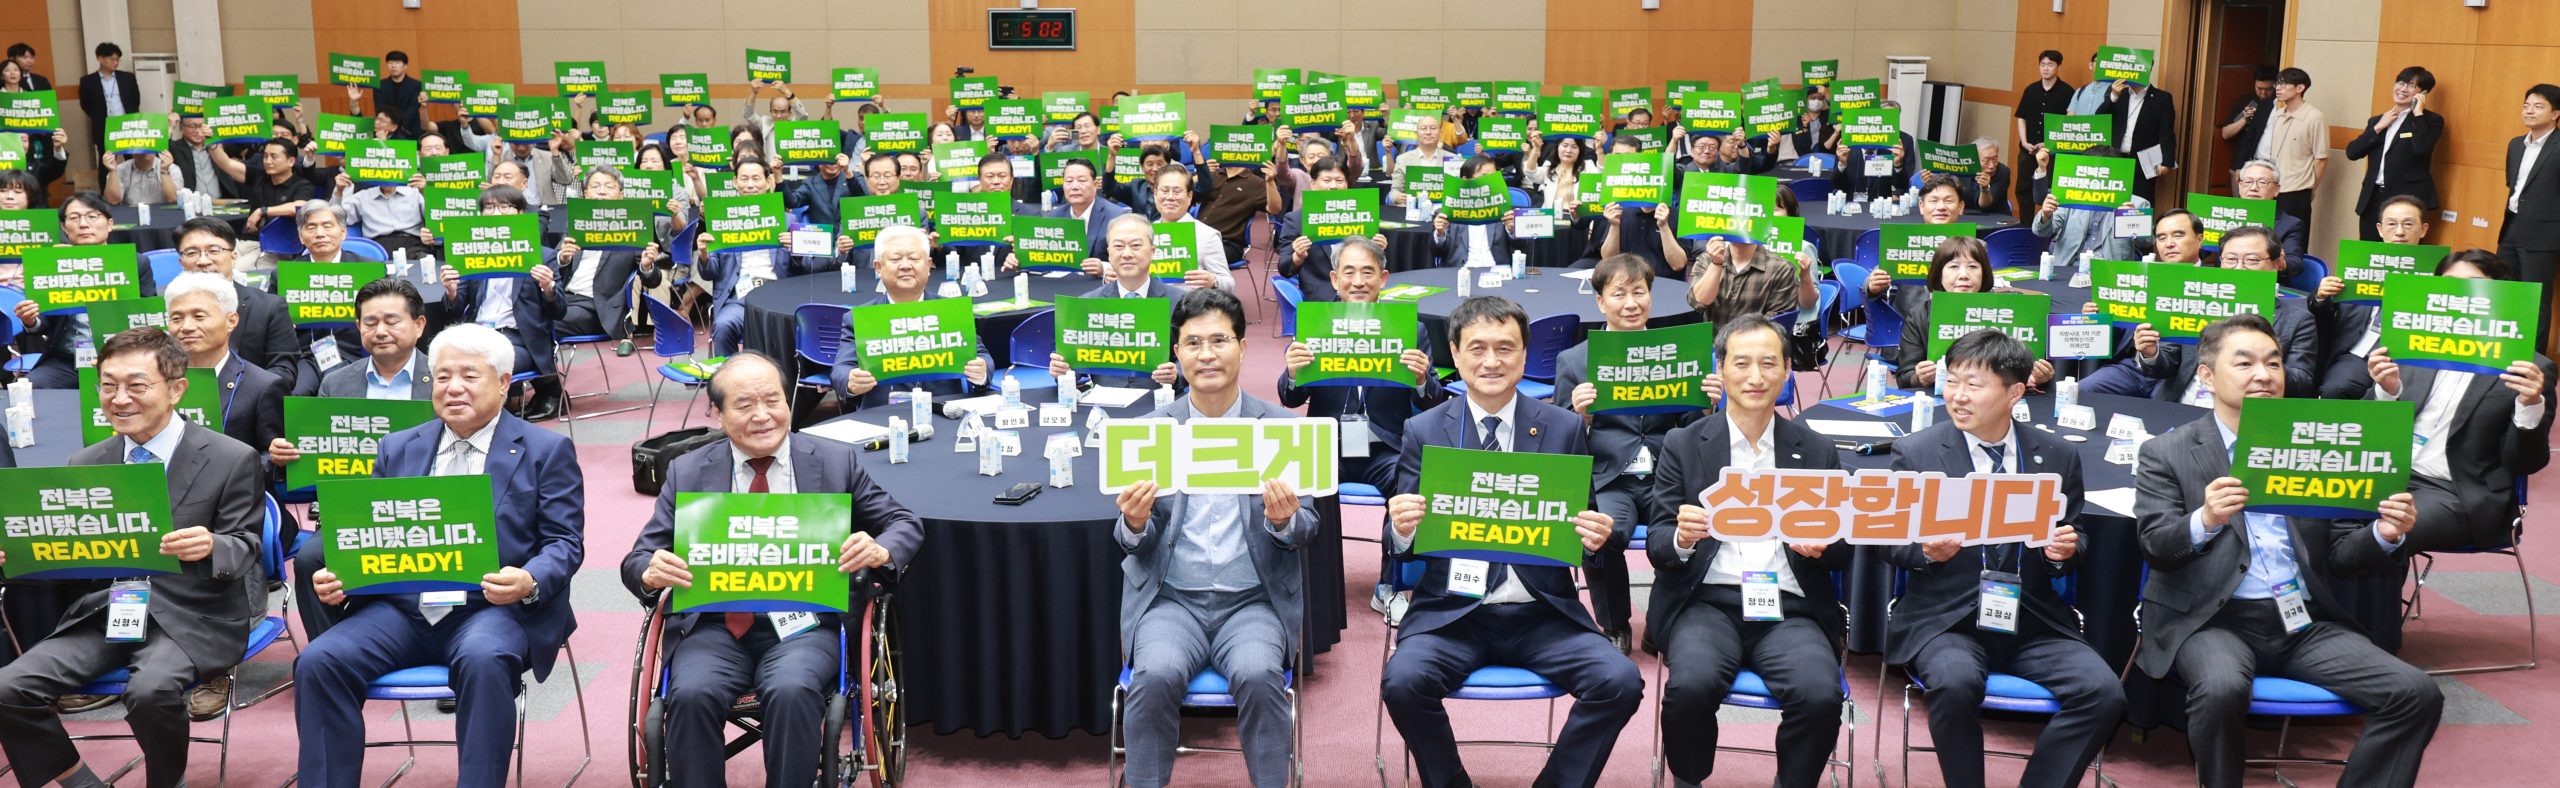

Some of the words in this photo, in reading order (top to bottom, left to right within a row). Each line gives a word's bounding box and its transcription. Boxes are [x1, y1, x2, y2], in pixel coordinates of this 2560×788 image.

[1299, 93, 1328, 104] 전북은
[220, 104, 247, 115] 전북은
[1137, 103, 1166, 113] 전북은
[122, 121, 149, 129] 전북은
[883, 121, 909, 130] 전북은
[1294, 114, 1334, 123] READY!
[217, 125, 257, 135] READY!
[794, 129, 820, 138] 전북은
[1131, 122, 1173, 133] READY!
[115, 139, 155, 148] READY!
[1228, 133, 1254, 142] 전북은
[878, 141, 915, 149] READY!
[366, 148, 390, 157] 전북은
[789, 150, 828, 158] READY!
[360, 169, 403, 178] READY!
[1621, 163, 1650, 174] 전북은
[2076, 166, 2109, 178] 전북은
[2058, 176, 2126, 191] 준비됐습니다.
[1460, 185, 1490, 197] 전북은
[1613, 188, 1657, 198] READY!
[1707, 185, 1747, 199] 전북은
[2066, 190, 2115, 202] READY!
[727, 205, 760, 218] 전북은
[864, 205, 897, 217] 전북은
[956, 202, 988, 213] 전북은
[1325, 200, 1356, 210] 전북은
[1686, 200, 1766, 218] 준비됐습니다.
[592, 209, 627, 219] 전북은
[941, 214, 1006, 225] 준비됐습니다.
[1308, 210, 1373, 224] 준비됐습니다.
[1453, 208, 1498, 218] READY!
[2211, 206, 2247, 220] 전북은
[574, 220, 646, 231] 준비됐습니다.
[712, 216, 779, 231] 준비됐습니다.
[1696, 216, 1752, 231] READY!
[471, 227, 510, 240] 전북은
[585, 231, 636, 242] READY!
[722, 231, 770, 242] READY!
[951, 227, 996, 236] READY!
[1034, 227, 1064, 239] 전북은
[1318, 225, 1364, 237] READY!
[452, 240, 533, 255] 준비됐습니다.
[1019, 238, 1082, 251] 준비됐습니다.
[465, 256, 522, 268] READY!
[1029, 252, 1073, 262] READY!
[2369, 254, 2414, 269] 전북은
[57, 258, 103, 272] 전북은
[33, 270, 129, 289] 준비됐습니다.
[309, 275, 353, 289] 전북은
[49, 289, 117, 303] READY!
[2184, 281, 2236, 300] 전북은
[2426, 294, 2491, 314] 전북은
[1088, 313, 1135, 328] 전북은
[1965, 307, 2013, 324] 전북은
[890, 315, 939, 336] 전북은
[1332, 318, 1382, 335] 전북은
[2392, 312, 2523, 338] 준비됐습니다.
[865, 332, 967, 356] 준비됐습니다.
[1063, 329, 1160, 347] 준비됐습니다.
[2409, 335, 2501, 357] READY!
[1077, 349, 1145, 364] READY!
[1627, 344, 1677, 363] 전북은
[883, 352, 953, 371] READY!
[1321, 358, 1391, 372] READY!
[1597, 361, 1703, 382] 준비됐습니다.
[1613, 383, 1687, 400] READY!
[330, 415, 391, 434] 전북은
[2291, 422, 2362, 445] 전북은
[1107, 424, 1172, 489] 더
[1187, 424, 1331, 489] 크게
[2248, 448, 2397, 473] 준비됐습니다.
[1471, 472, 1539, 495] 전북은
[2266, 476, 2373, 498] READY!
[39, 488, 113, 510] 전북은
[371, 499, 441, 521] 전북은
[1432, 497, 1573, 522] 준비됐습니다.
[1709, 474, 2060, 545] 성장합니다
[4, 513, 157, 537] 준비됐습니다.
[728, 516, 799, 539] 전북은
[337, 524, 483, 549] 준비됐습니다.
[1450, 522, 1550, 545] READY!
[32, 540, 139, 560] READY!
[687, 544, 836, 566] 준비됐습니다.
[361, 552, 462, 573] READY!
[710, 571, 813, 591] READY!
[1455, 572, 1480, 583] 김희수
[1748, 598, 1775, 606] 정인선
